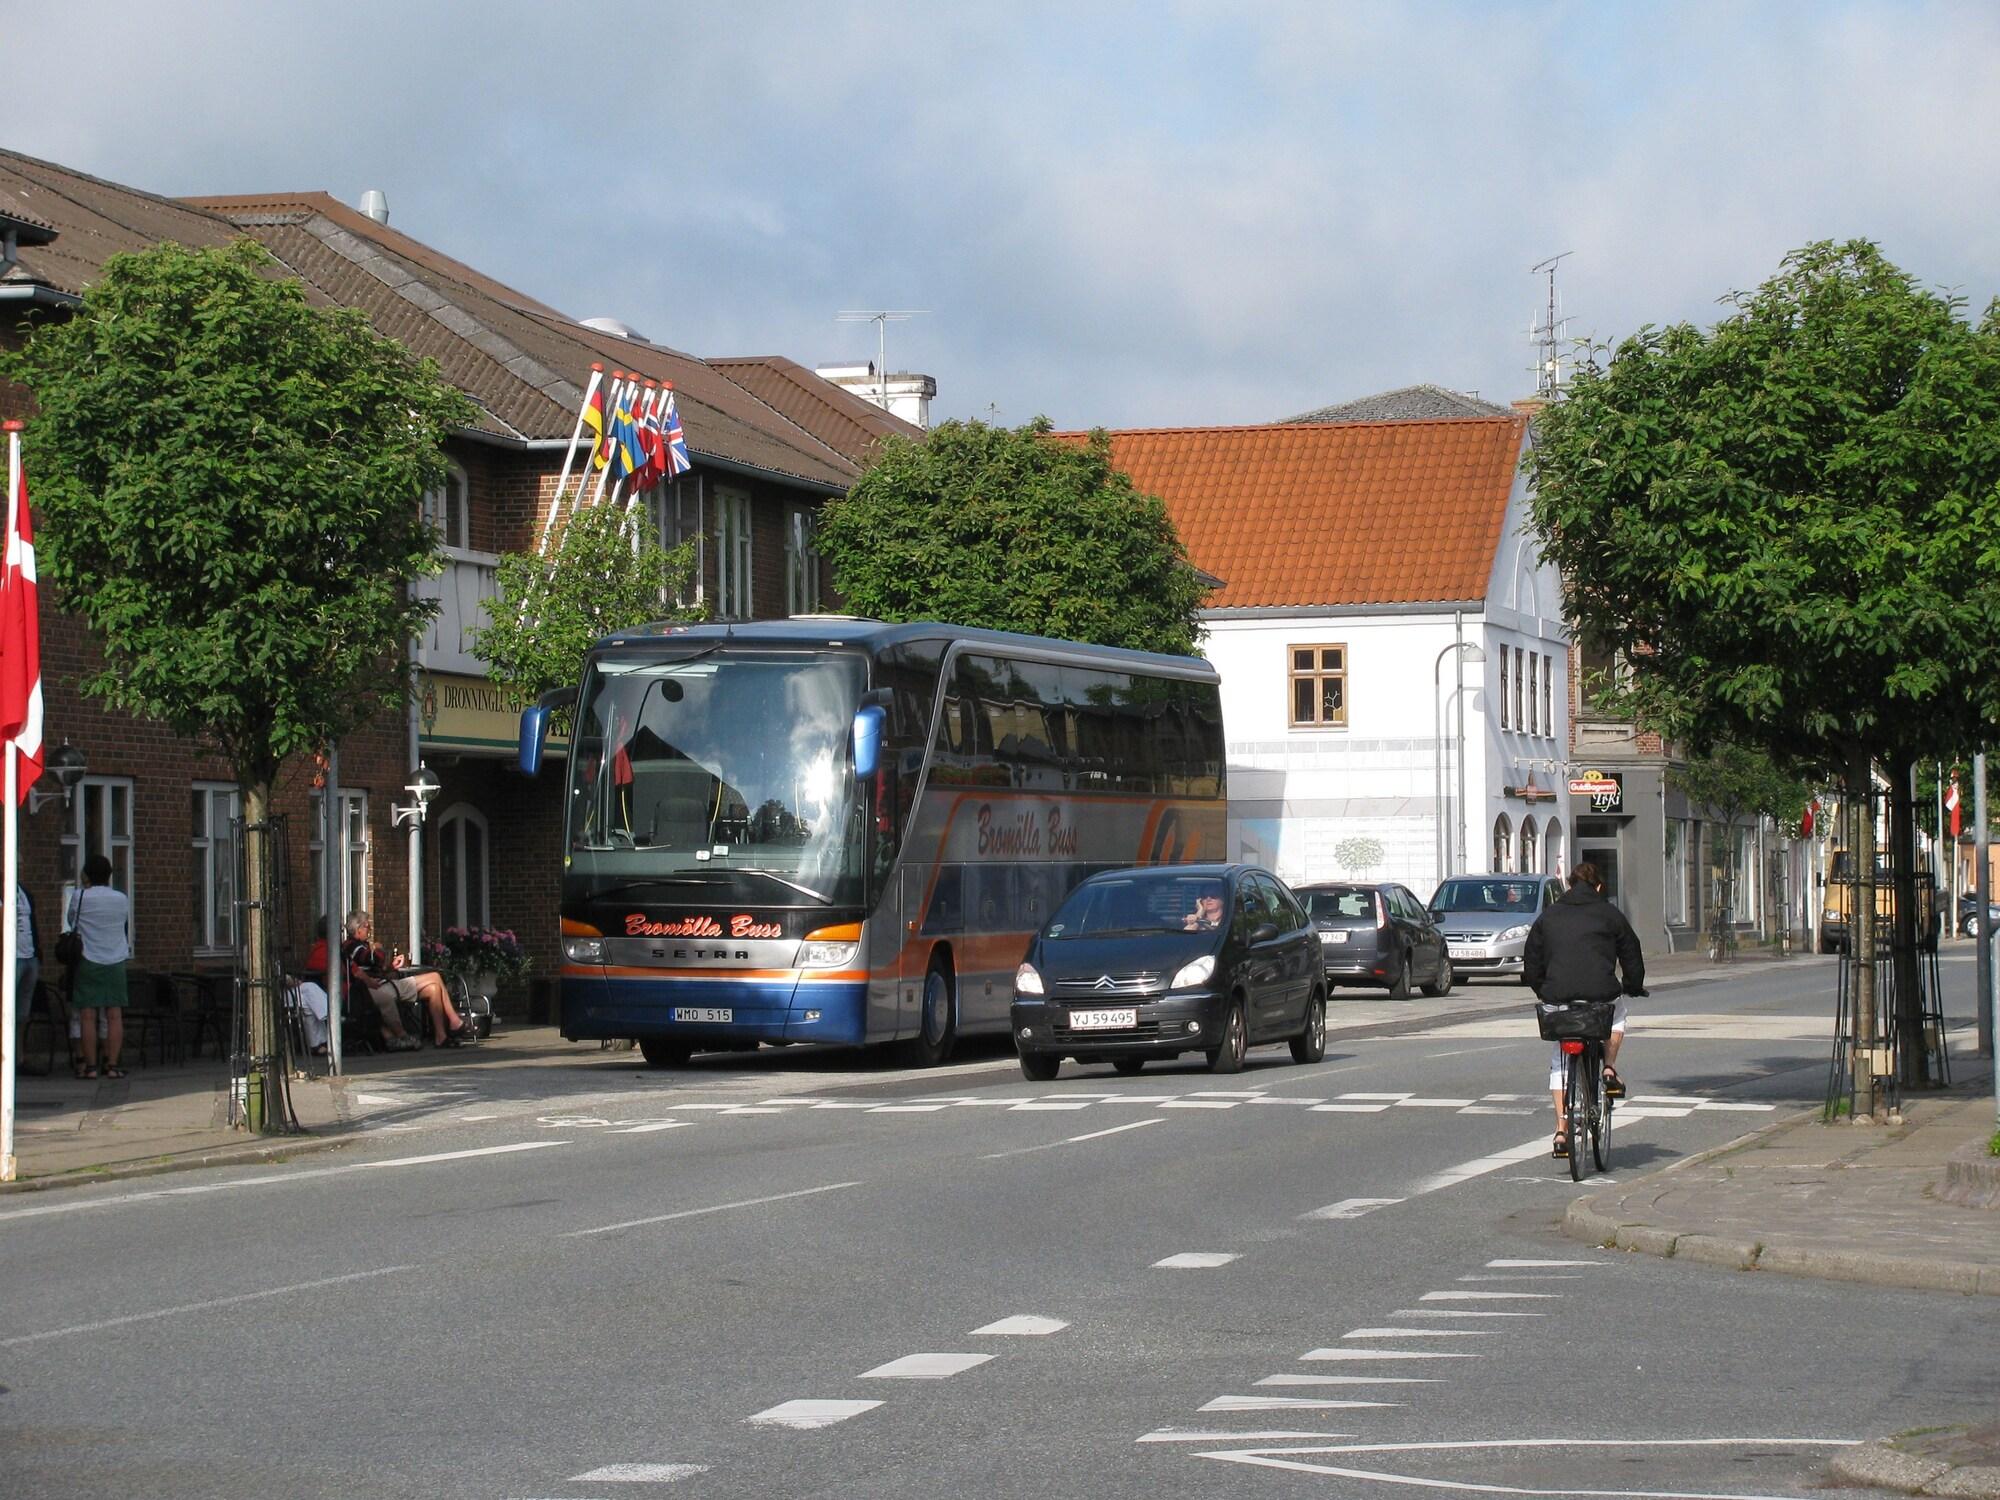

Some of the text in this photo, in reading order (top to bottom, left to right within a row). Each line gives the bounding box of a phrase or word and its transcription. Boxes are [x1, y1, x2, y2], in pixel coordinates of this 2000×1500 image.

[977, 802, 1079, 856] Bromölla Buss
[625, 914, 782, 938] Bromölla Buss
[652, 950, 749, 959] SETRA
[676, 1008, 730, 1021] WMO 515
[1072, 1012, 1134, 1025] YJ 59 495
